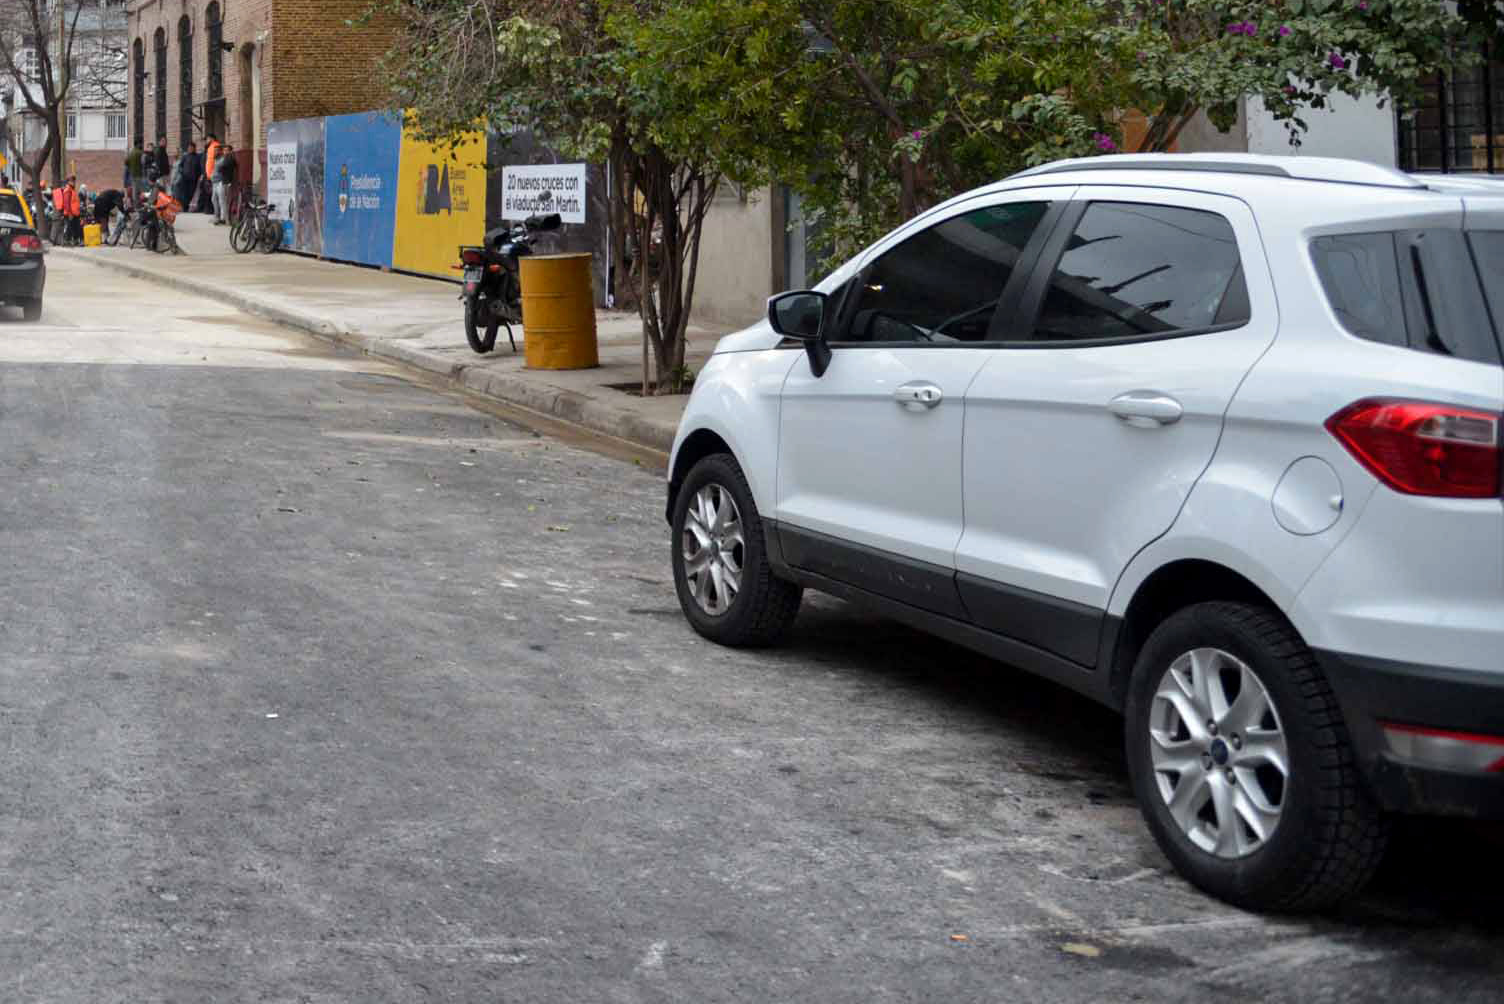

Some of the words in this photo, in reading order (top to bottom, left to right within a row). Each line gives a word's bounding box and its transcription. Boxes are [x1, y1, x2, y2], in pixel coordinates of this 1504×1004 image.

[507, 174, 516, 190] 20
[517, 177, 540, 190] nuevos
[541, 176, 564, 190] cruces
[565, 176, 578, 190] con
[506, 195, 512, 210] el
[541, 199, 555, 212] San
